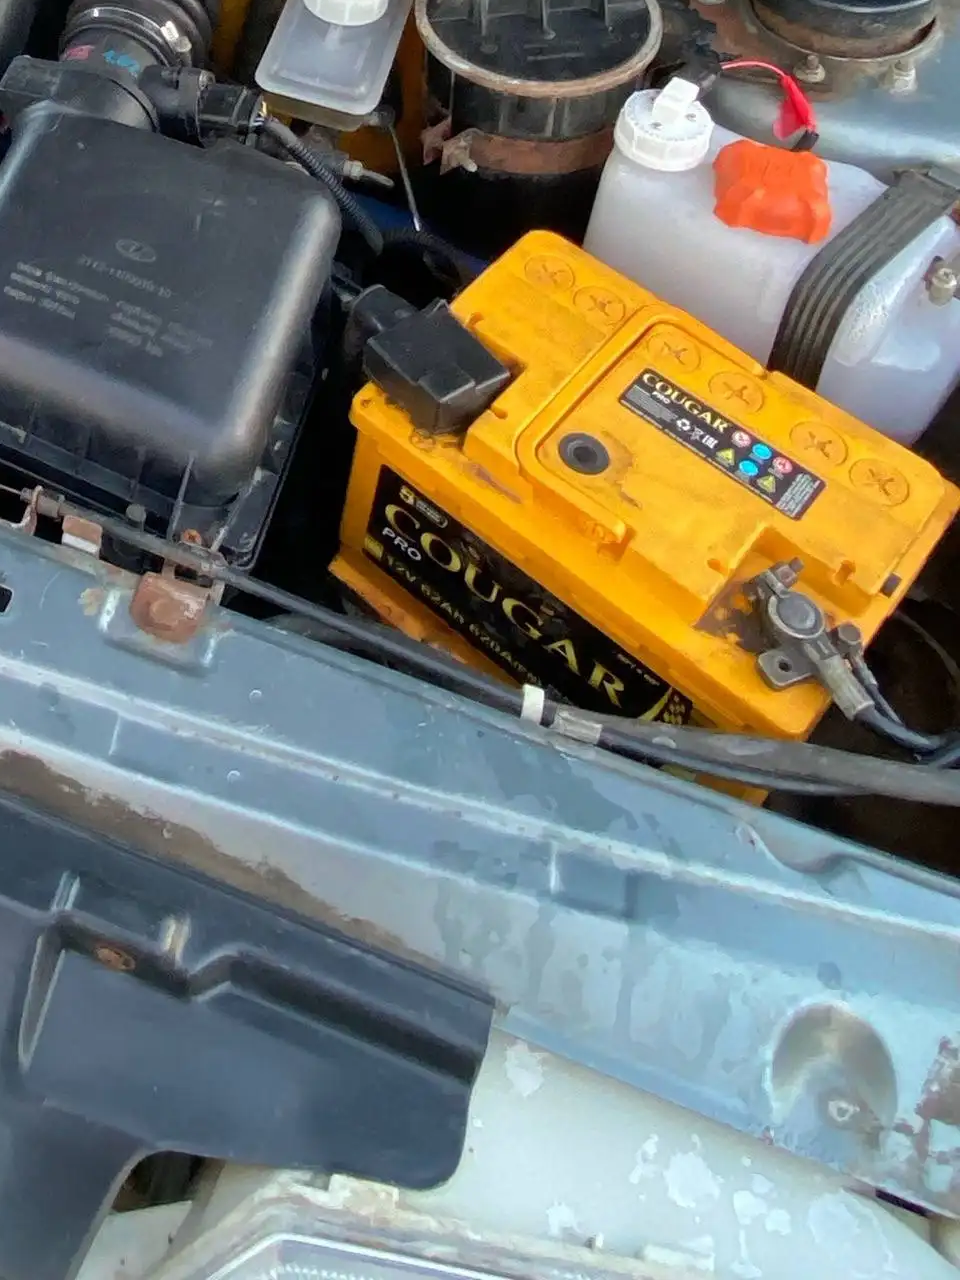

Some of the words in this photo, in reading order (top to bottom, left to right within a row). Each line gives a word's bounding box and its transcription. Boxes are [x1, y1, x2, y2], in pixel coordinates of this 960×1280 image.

[642, 372, 730, 434] COUGAR
[381, 526, 422, 561] PRO
[385, 503, 625, 708] COUGAR
